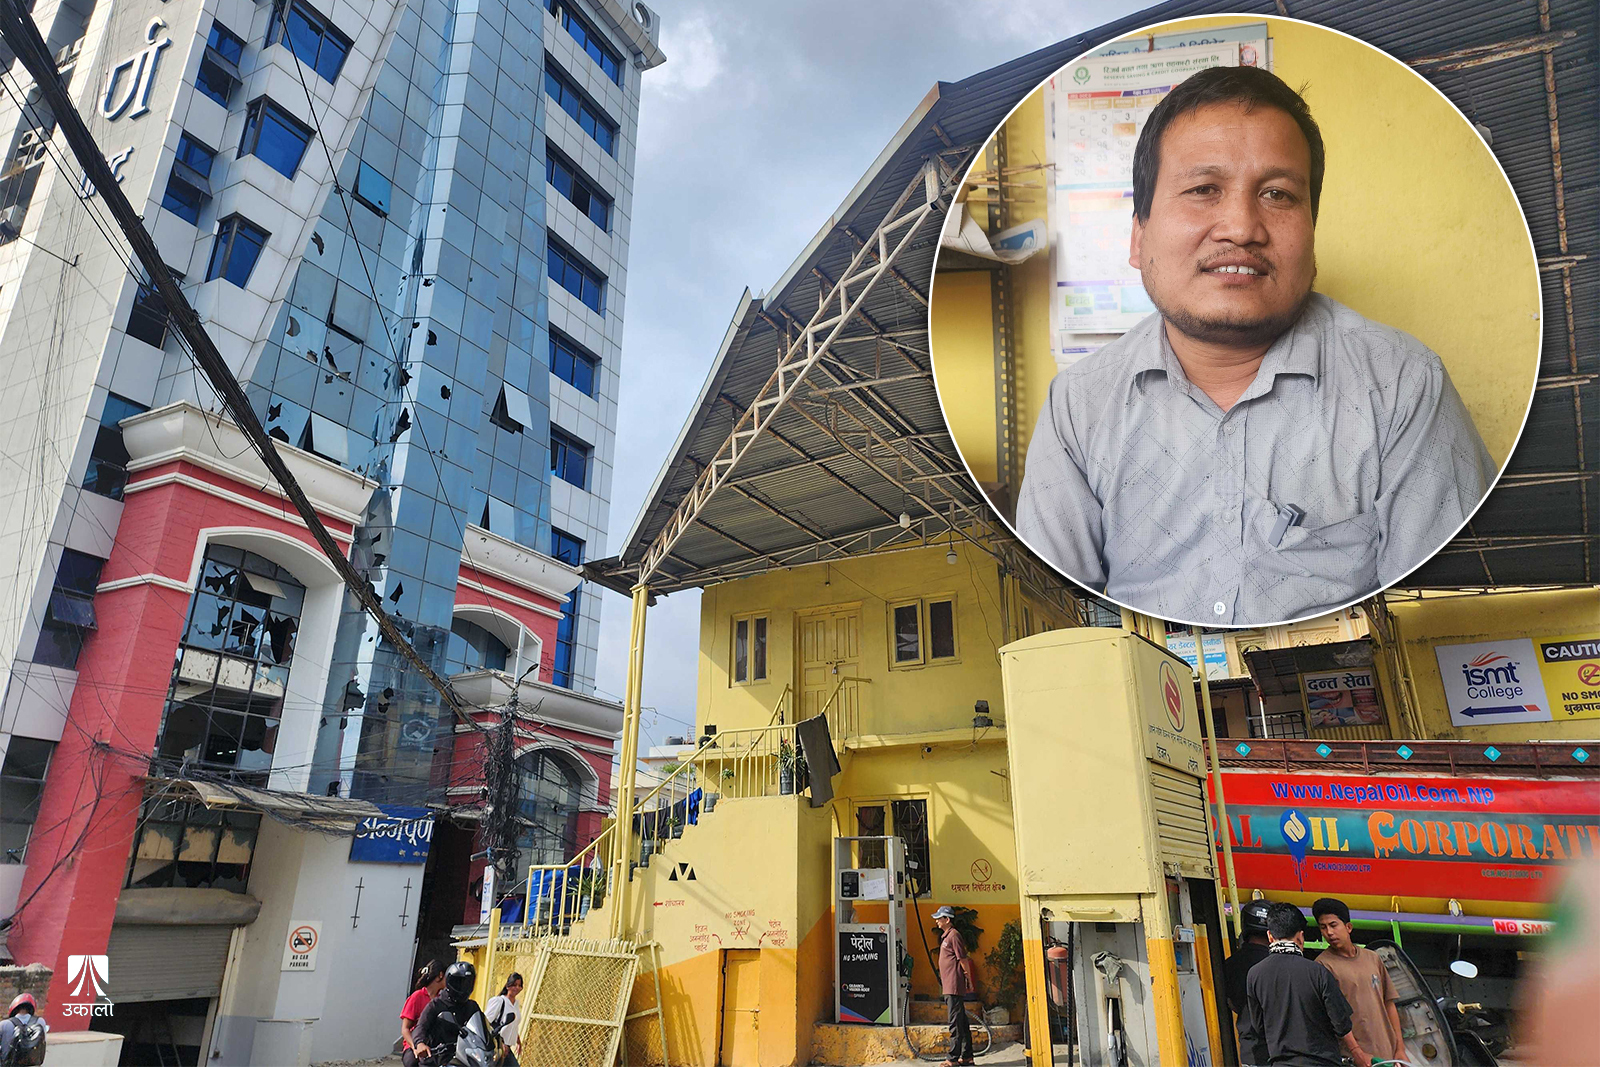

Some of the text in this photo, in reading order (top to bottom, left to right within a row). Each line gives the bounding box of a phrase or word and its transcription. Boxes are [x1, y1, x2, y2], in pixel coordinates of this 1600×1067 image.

[1462, 661, 1520, 686] ismt
[1307, 673, 1370, 690] दन्त सेवा
[1467, 686, 1523, 699] College
[1562, 692, 1579, 701] NO
[1493, 920, 1549, 934] NO SM
[850, 934, 874, 952] पेट्रोल
[851, 952, 878, 961] SMOKING
